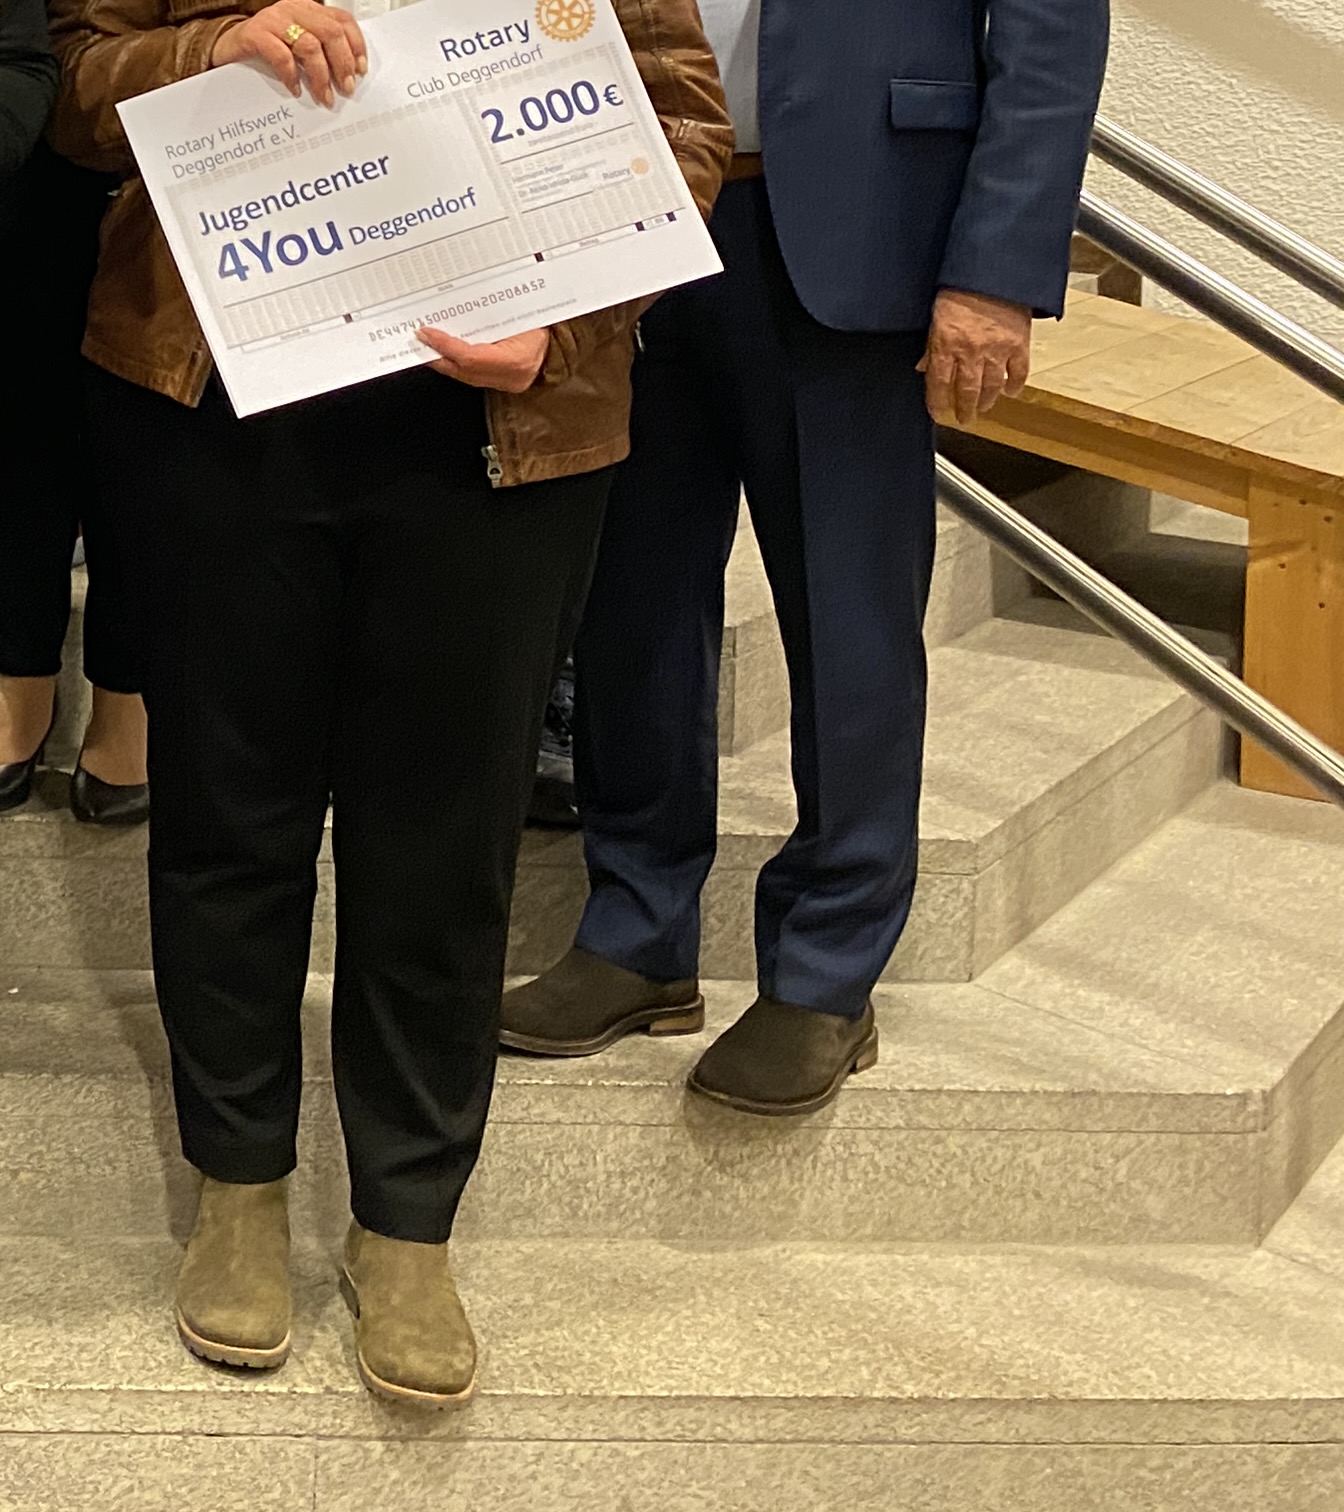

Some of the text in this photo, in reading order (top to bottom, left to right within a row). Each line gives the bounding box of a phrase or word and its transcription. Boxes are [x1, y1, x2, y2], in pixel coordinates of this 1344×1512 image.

[439, 18, 531, 62] Rotary
[407, 44, 545, 99] Club Deggendorf
[164, 104, 293, 160] Rotary Hilfswerk
[171, 123, 301, 179] Deggendorf e.V.
[198, 153, 391, 236] Jugendcenter
[217, 185, 480, 282] 4You Deggendorf
